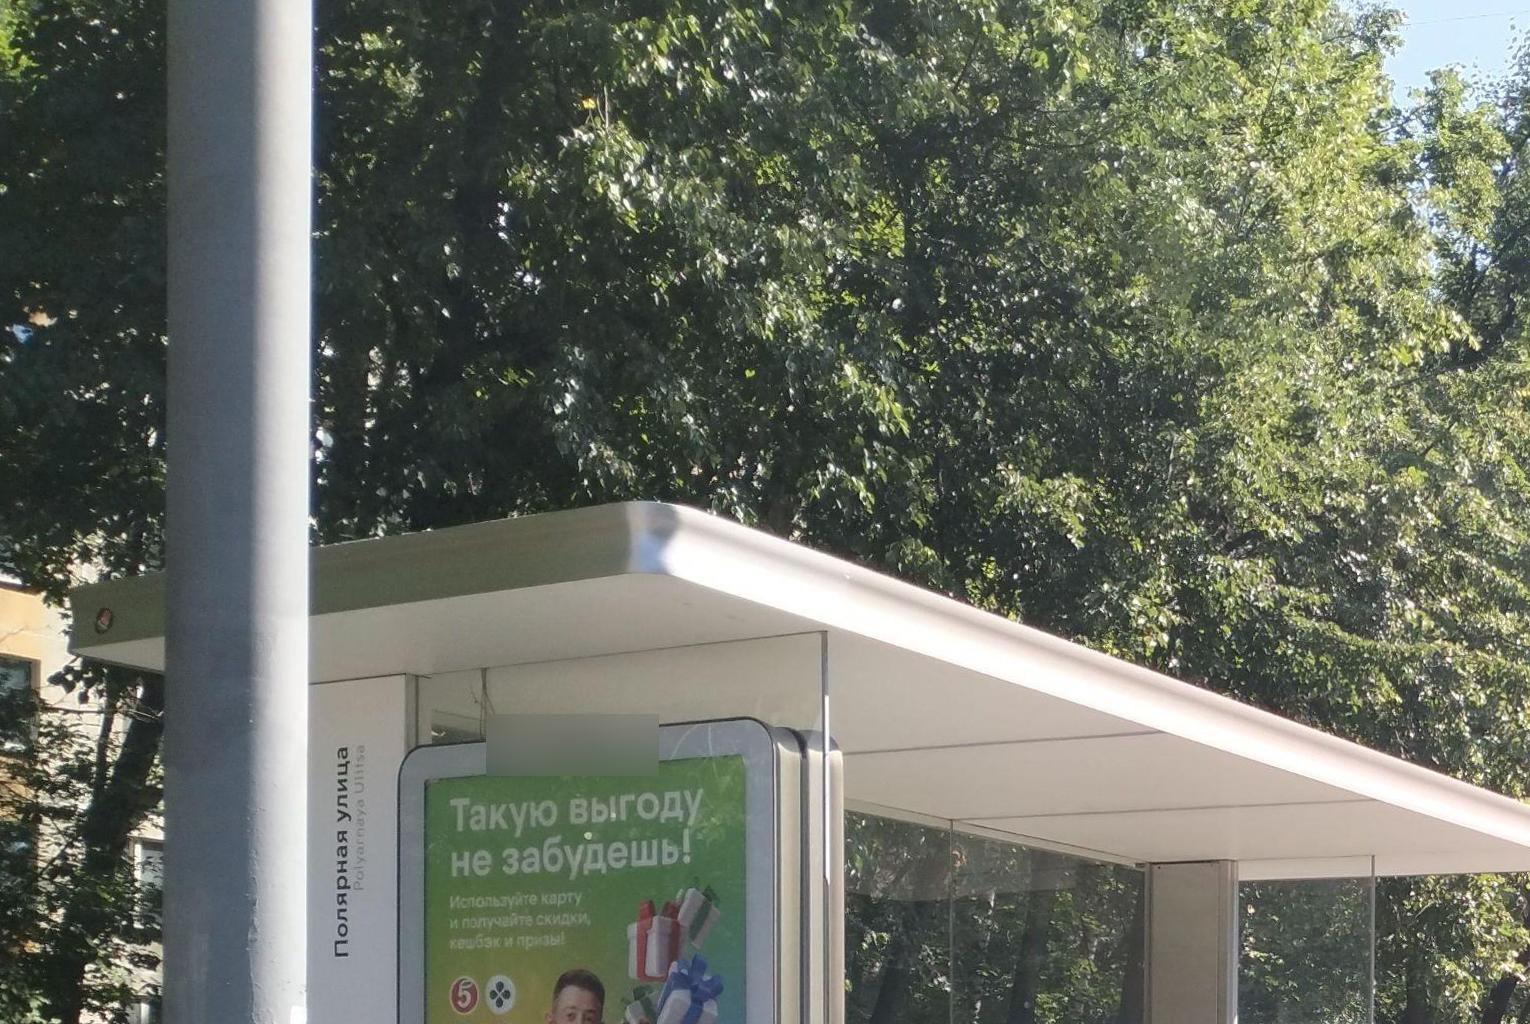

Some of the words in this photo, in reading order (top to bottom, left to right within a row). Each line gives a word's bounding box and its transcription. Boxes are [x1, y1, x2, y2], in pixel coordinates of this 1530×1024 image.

[337, 747, 352, 822] улица
[450, 797, 558, 838] Такую
[569, 788, 704, 826] выгоду
[353, 799, 367, 891] Polyarnaya
[451, 850, 492, 877] не
[502, 828, 691, 881] забудешь!
[334, 830, 351, 958] Полярная
[449, 891, 537, 909] Используйте
[541, 891, 582, 908] карту
[450, 918, 458, 929] и
[462, 911, 534, 930] получайте
[536, 912, 592, 926] скидки,
[504, 936, 513, 948] и
